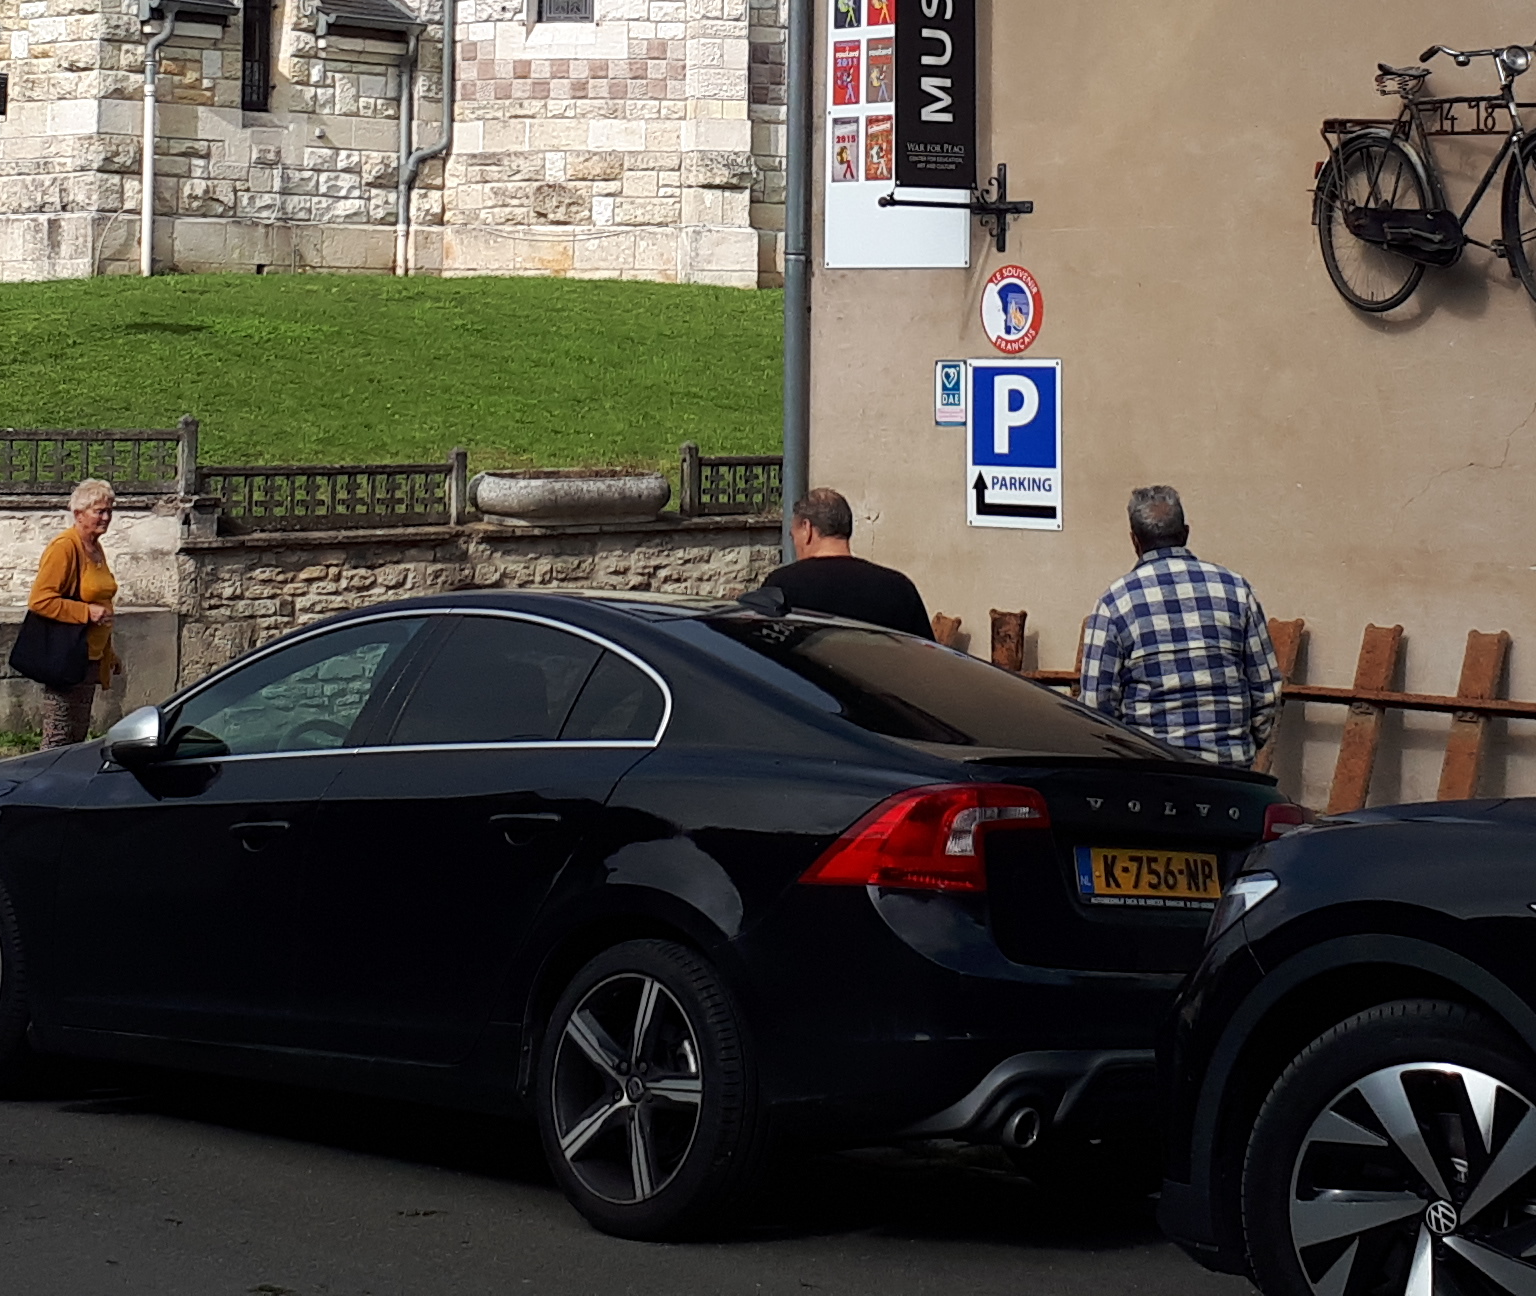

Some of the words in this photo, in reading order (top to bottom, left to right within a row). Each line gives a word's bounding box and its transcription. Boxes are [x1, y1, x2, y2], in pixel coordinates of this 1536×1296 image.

[837, 58, 858, 67] 2011
[836, 134, 857, 144] 2015
[992, 271, 1002, 283] LE
[1002, 267, 1038, 294] SOUVENIR
[996, 329, 1036, 351] FRANÇAIS
[942, 394, 960, 405] DAE
[993, 374, 1039, 454] P
[990, 475, 1052, 492] PARKING
[1086, 797, 1240, 820] VOLVO
[1080, 875, 1091, 886] NL
[1102, 854, 1214, 892] K-756-NP
